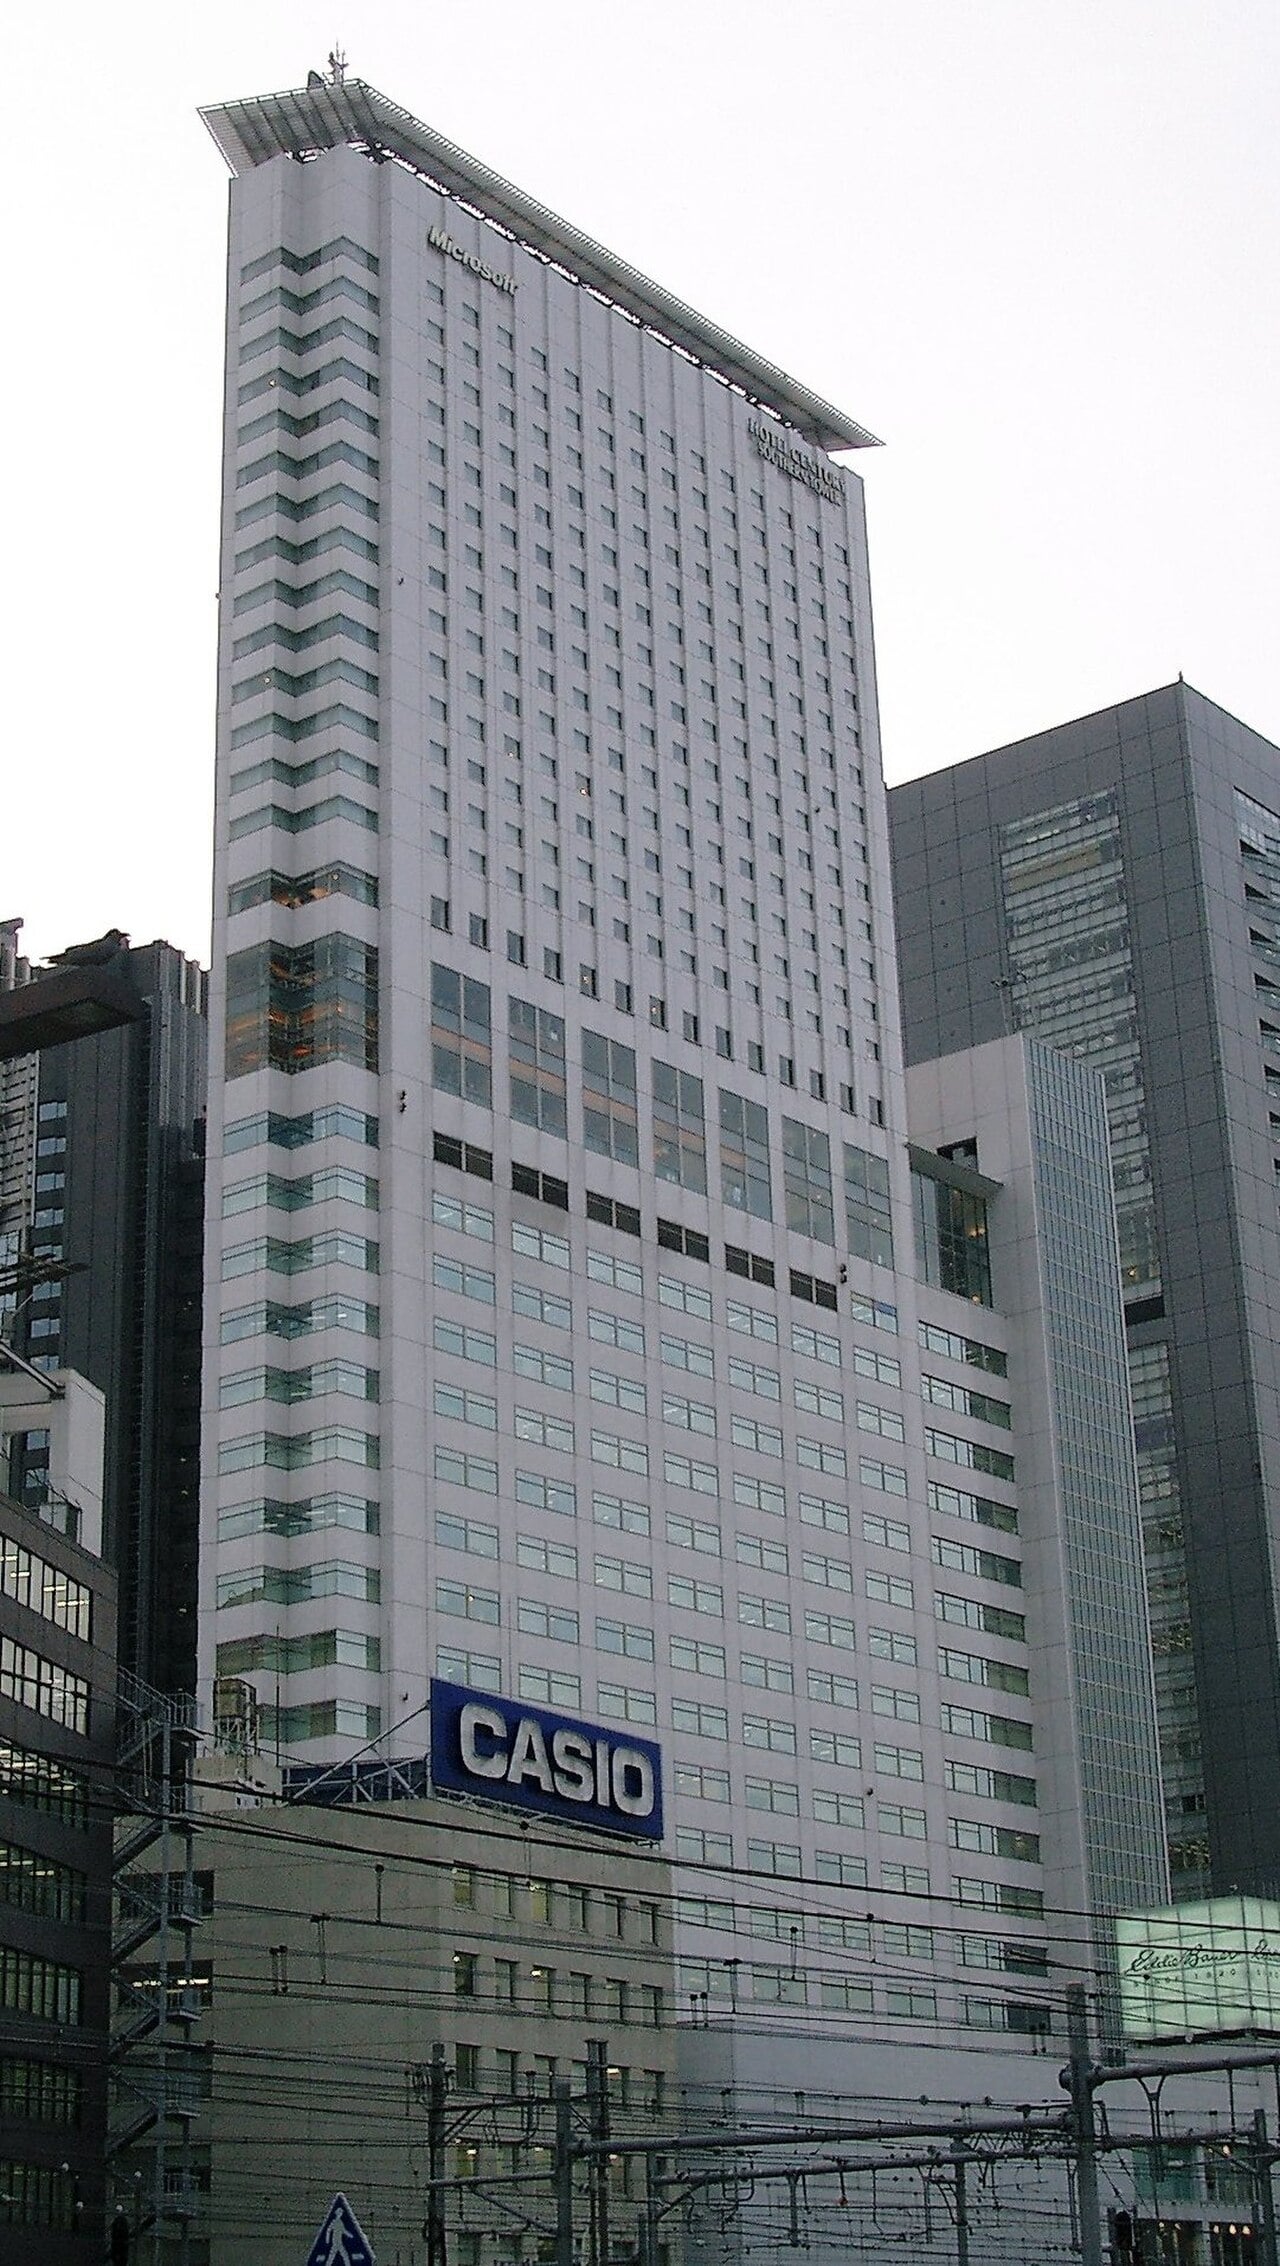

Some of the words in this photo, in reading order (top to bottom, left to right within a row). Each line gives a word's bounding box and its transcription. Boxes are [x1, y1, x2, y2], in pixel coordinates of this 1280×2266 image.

[427, 225, 518, 297] Microsoft
[460, 1702, 655, 1818] CASIO
[1124, 1949, 1181, 1975] Eddie
